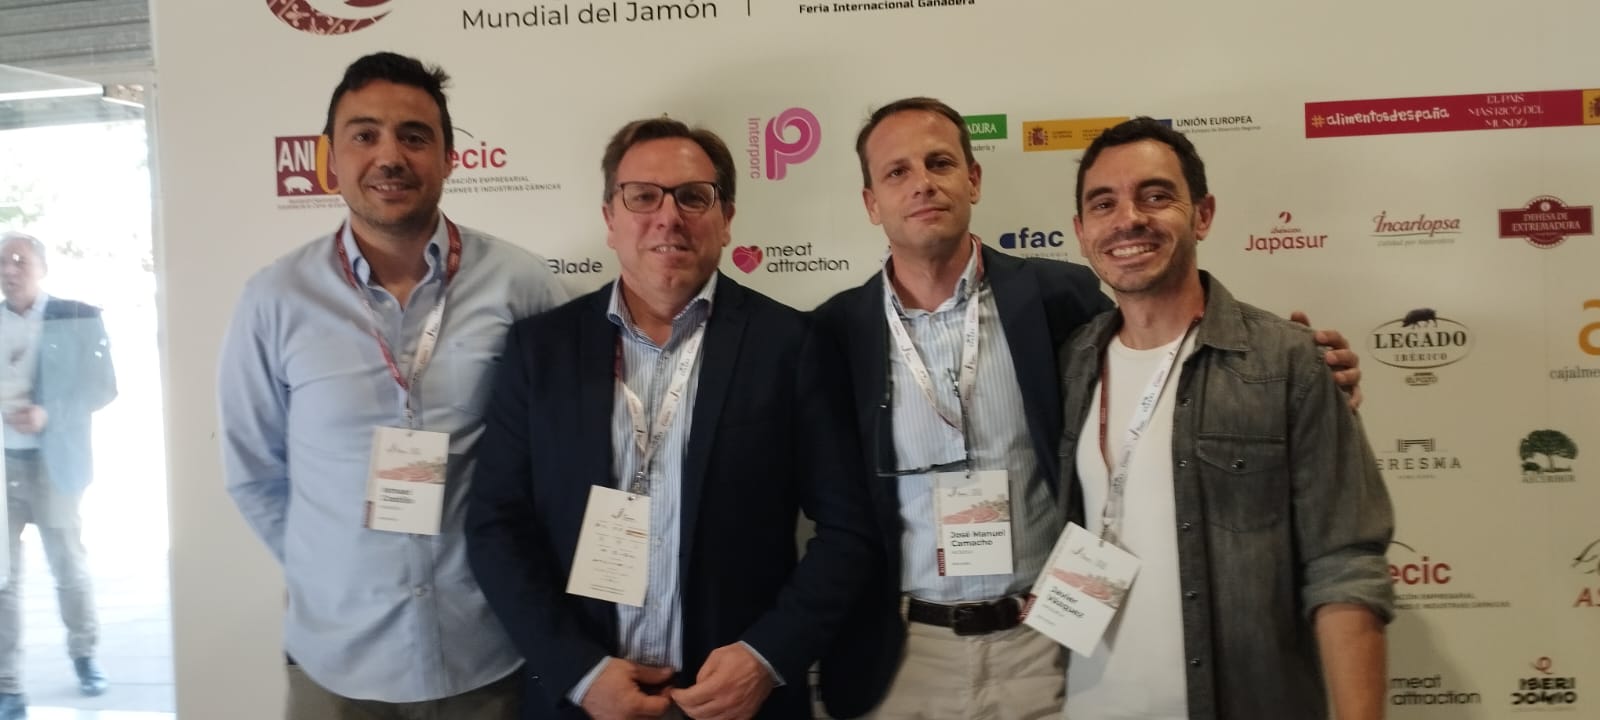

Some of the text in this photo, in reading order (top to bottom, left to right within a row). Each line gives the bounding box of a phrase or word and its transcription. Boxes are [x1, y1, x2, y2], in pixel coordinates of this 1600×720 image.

[462, 0, 718, 30] Mundial del Jamón
[799, 4, 830, 14] Feria
[833, 0, 914, 12] Internacional
[1176, 115, 1253, 127] UNIÓN EUROPEA
[1311, 107, 1450, 128] #alimentosdespaña
[448, 141, 507, 169] ecic
[748, 117, 761, 180] Interporc
[1524, 212, 1568, 222] DEHESA DE
[1511, 220, 1582, 232] EXTREMADURA
[1018, 227, 1064, 248] fac
[1246, 234, 1328, 254] Japasur
[766, 242, 812, 257] meat
[547, 257, 603, 274] Blade
[766, 258, 850, 273] attraction
[1374, 330, 1467, 349] LEGADO
[1389, 556, 1452, 584] ecic
[1391, 675, 1441, 688] meat
[1391, 692, 1481, 705] attraction
